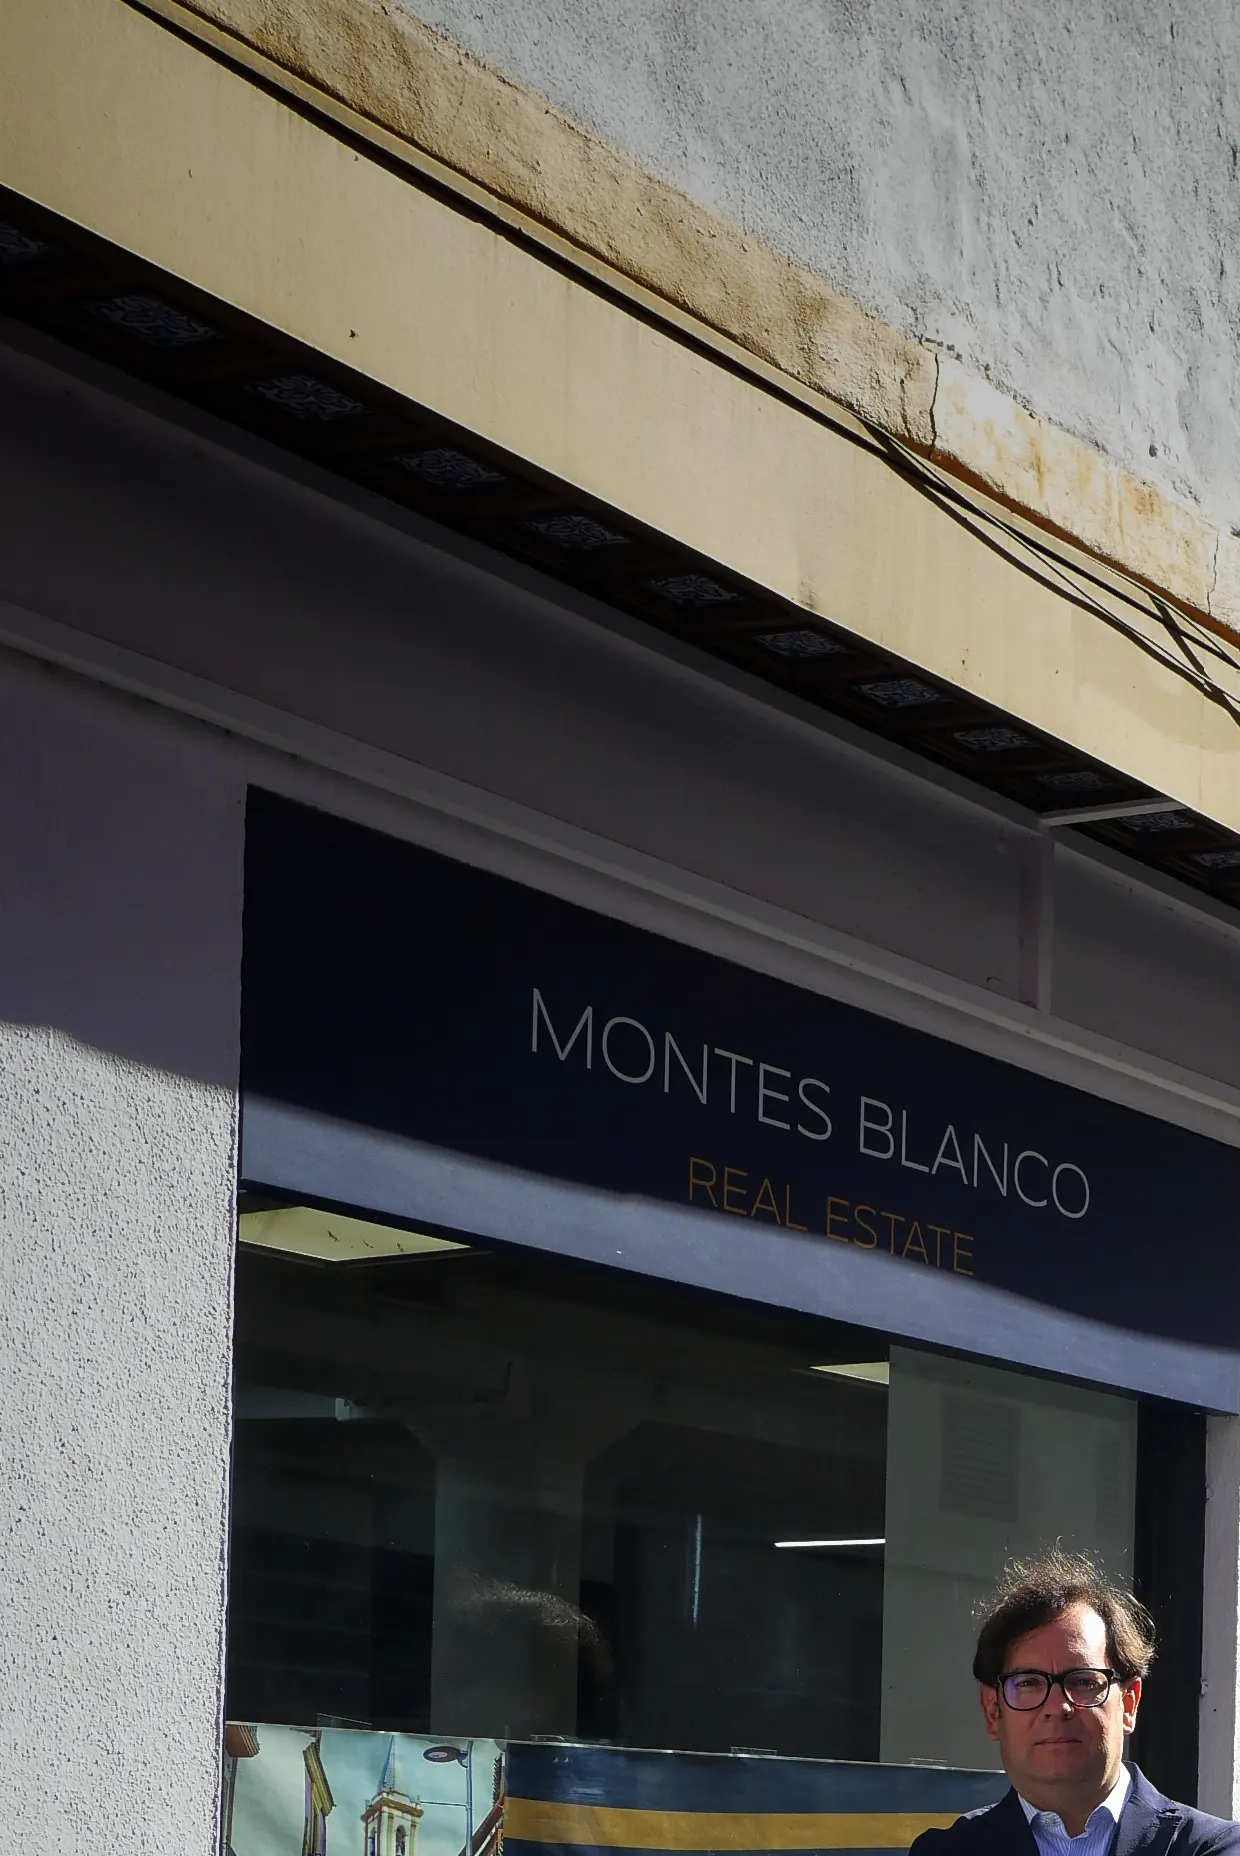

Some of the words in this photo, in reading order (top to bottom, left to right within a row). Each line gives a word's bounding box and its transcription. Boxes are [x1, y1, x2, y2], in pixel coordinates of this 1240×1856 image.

[531, 988, 833, 1140] MONTES
[859, 1095, 1090, 1219] BLANCO
[688, 1156, 808, 1232] REAL
[826, 1196, 975, 1276] ESTATE
